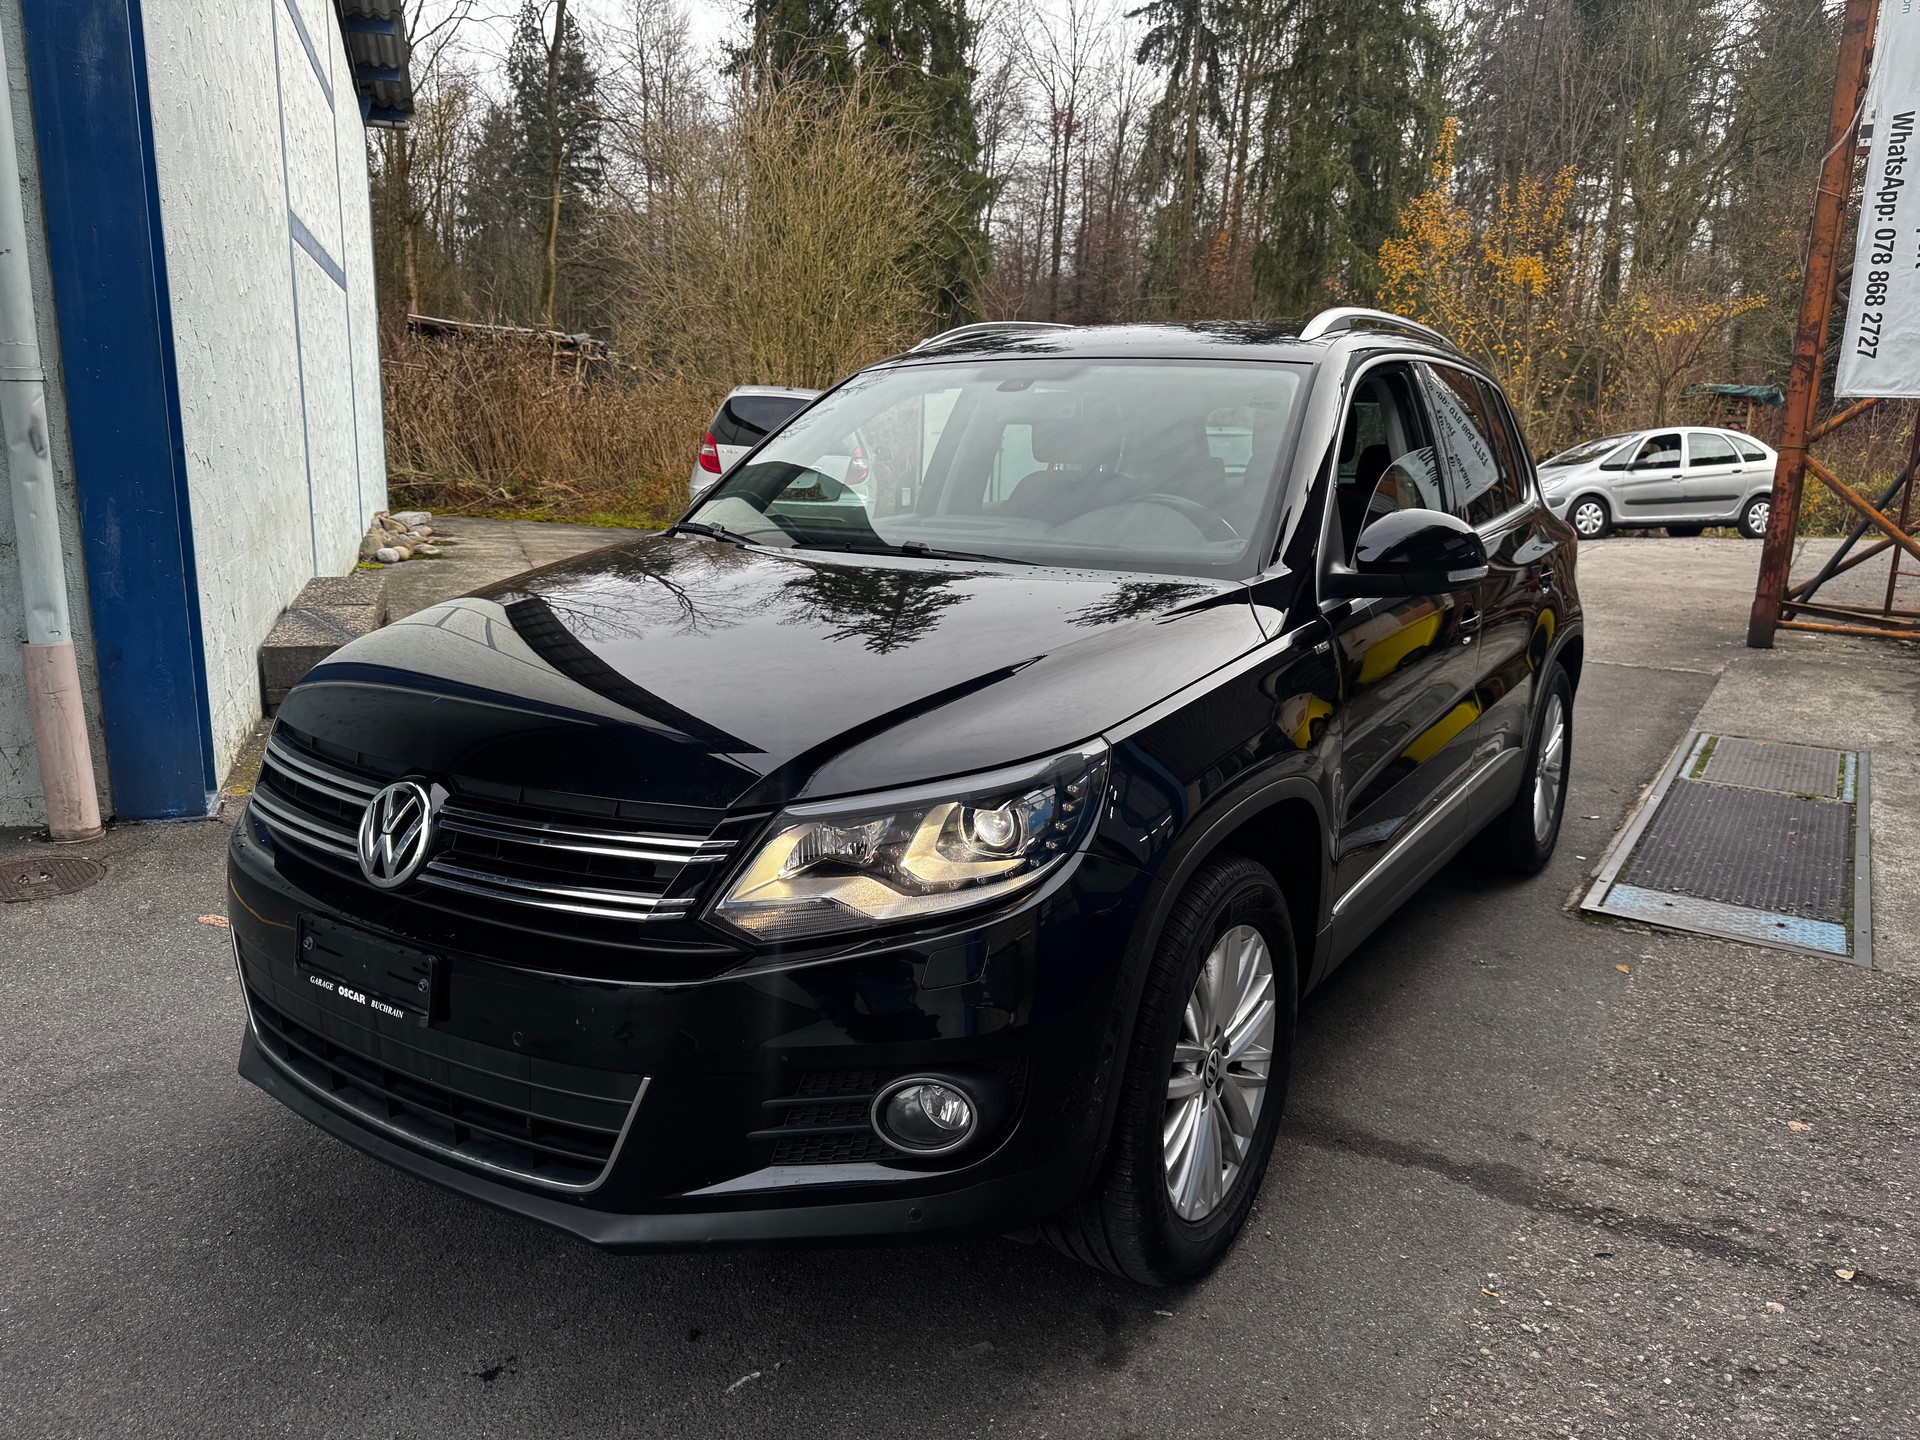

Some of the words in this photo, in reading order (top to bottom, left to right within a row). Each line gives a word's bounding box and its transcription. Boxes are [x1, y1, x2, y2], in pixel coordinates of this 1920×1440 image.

[1874, 110, 1916, 222] WhatsApp:
[1870, 228, 1897, 265] 078
[1864, 270, 1890, 307] 868
[1856, 312, 1883, 359] 2727
[309, 975, 334, 991] GARAGE
[338, 985, 366, 1005] OSCAR
[370, 1000, 404, 1019] BUCHRAIN
